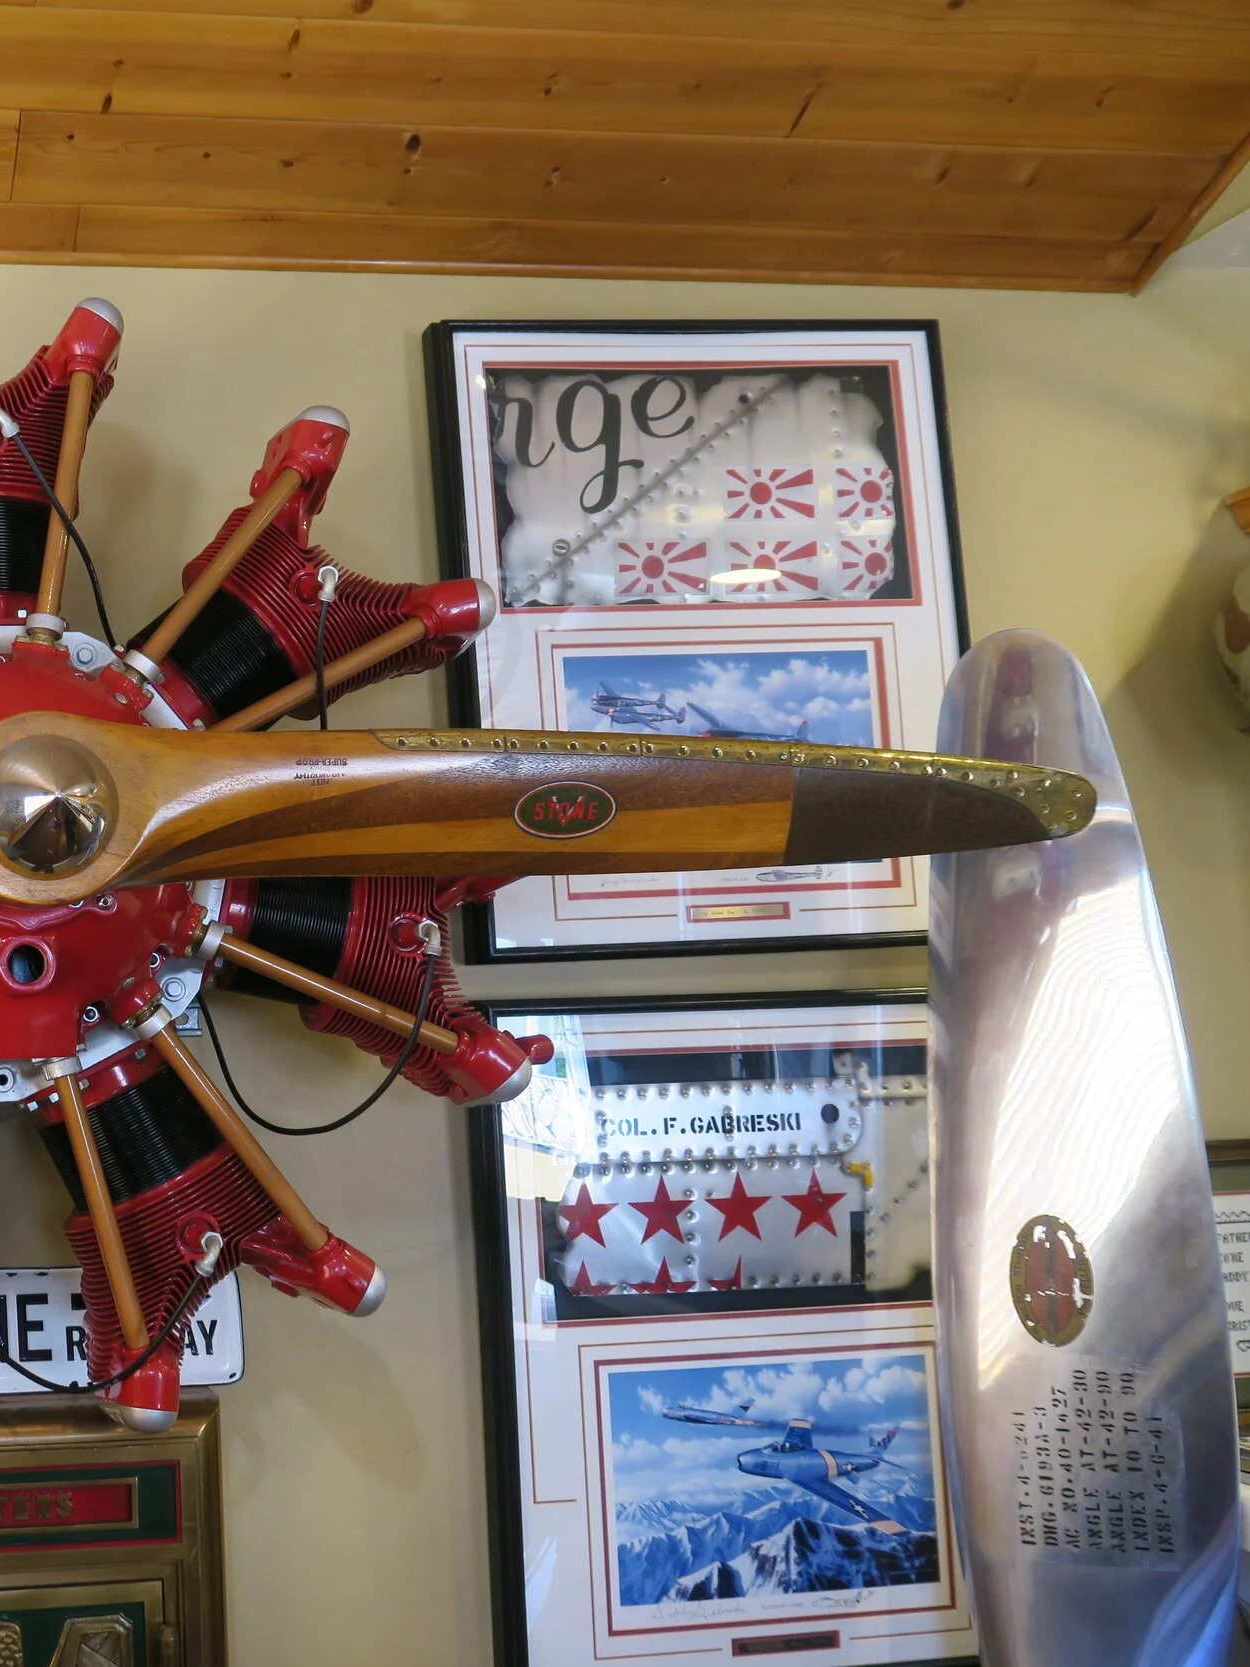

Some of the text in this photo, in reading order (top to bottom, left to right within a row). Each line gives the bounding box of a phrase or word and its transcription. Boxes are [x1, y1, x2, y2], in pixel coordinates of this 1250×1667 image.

[533, 801, 599, 821] STONE
[600, 1117, 657, 1137] COL.
[1122, 1411, 1140, 1436] TO
[1083, 1487, 1103, 1550] ANGLE
[1105, 1490, 1127, 1553] ANGLE
[1129, 1490, 1151, 1551] INDEX
